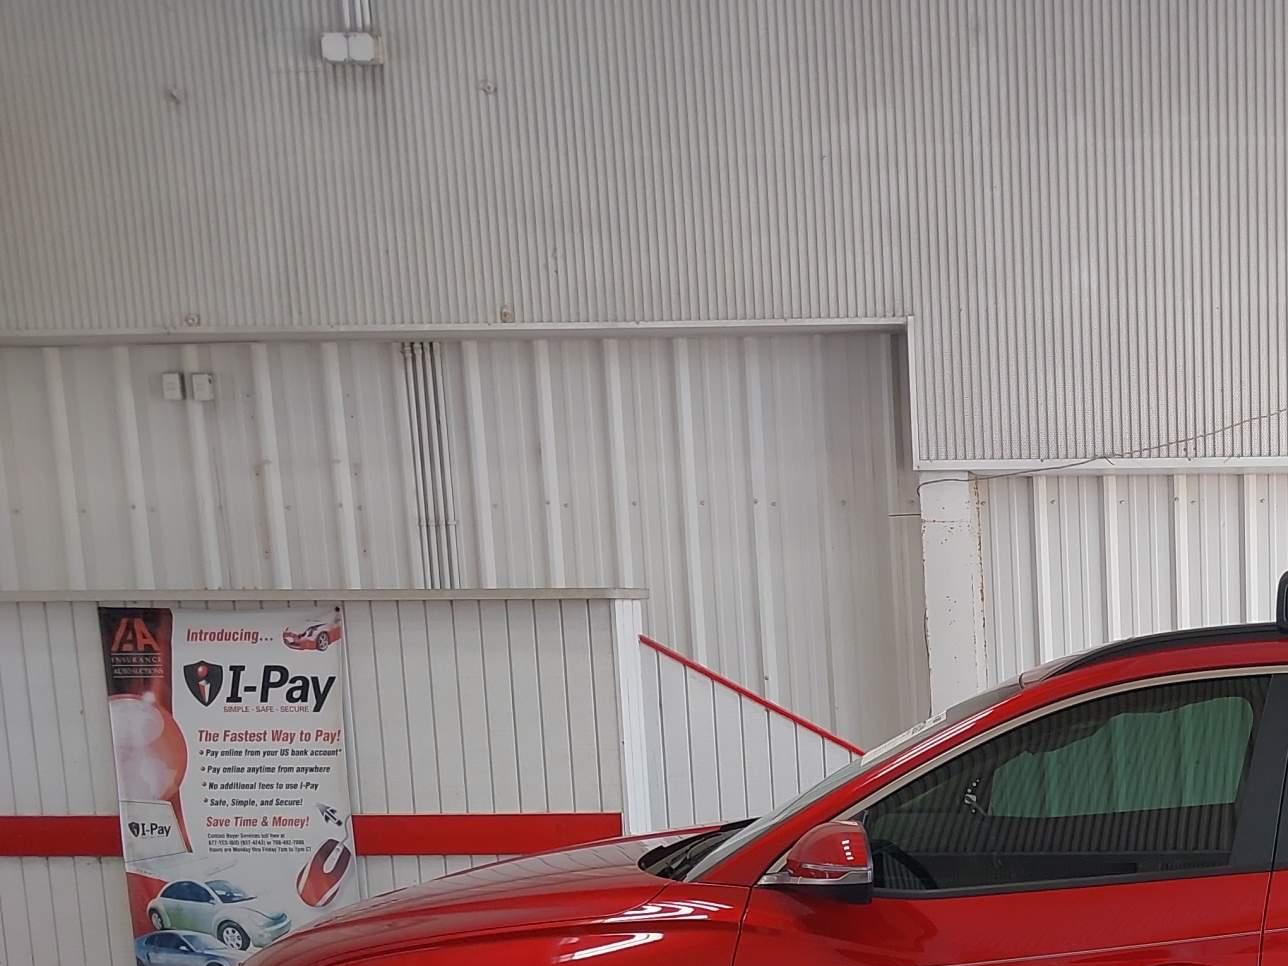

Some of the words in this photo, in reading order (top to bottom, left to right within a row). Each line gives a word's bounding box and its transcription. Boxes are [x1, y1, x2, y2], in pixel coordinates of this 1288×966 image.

[186, 628, 273, 644] Introducing...
[226, 665, 336, 712] I-Pay
[198, 730, 219, 742] The
[223, 730, 266, 742] Fastest
[272, 730, 295, 744] Way
[300, 731, 311, 742] to
[315, 730, 340, 744] Pay!
[206, 749, 218, 758] Pay
[262, 750, 278, 758] your
[207, 766, 220, 774] Pay
[247, 766, 276, 774] anytime
[296, 766, 330, 774] anywhere
[220, 782, 256, 790] additional
[210, 799, 228, 807] Safe,
[231, 799, 258, 807] Simple,
[206, 817, 230, 827] Save
[234, 817, 257, 826] Time
[261, 817, 268, 826] &
[272, 816, 310, 828] Money!
[141, 823, 171, 837] I-Pay
